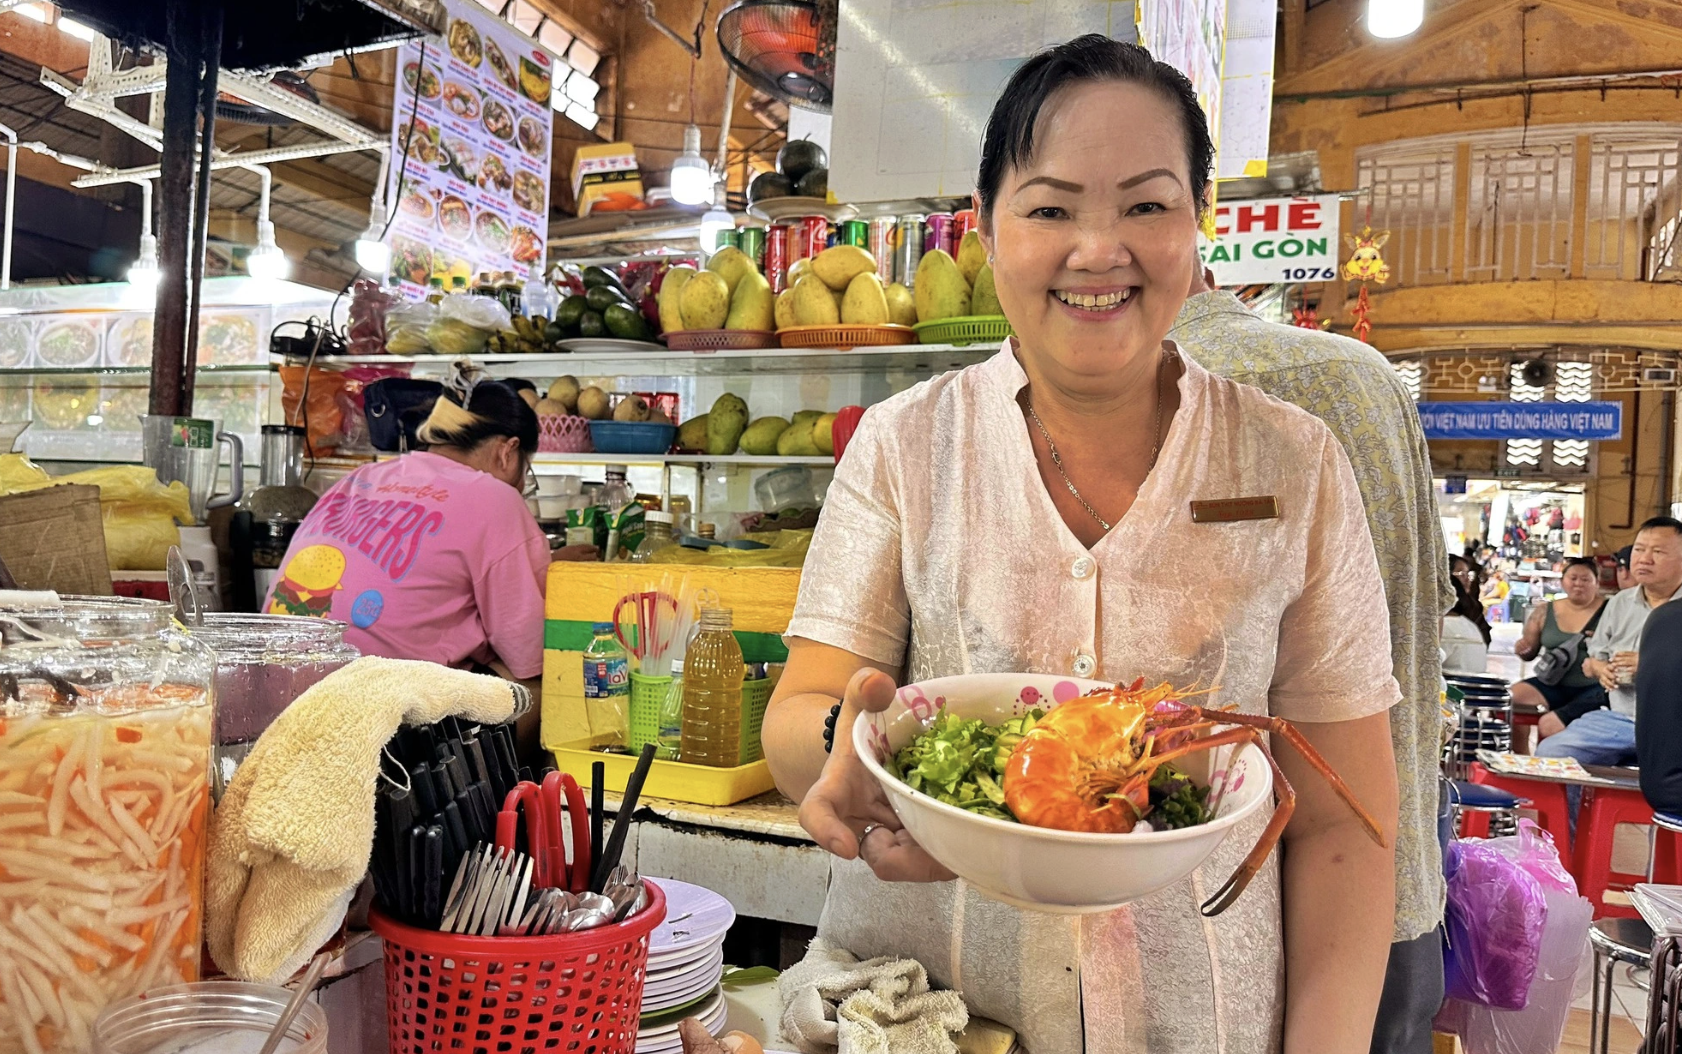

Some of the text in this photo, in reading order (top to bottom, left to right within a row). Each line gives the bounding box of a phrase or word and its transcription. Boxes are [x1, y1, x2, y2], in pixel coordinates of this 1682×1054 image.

[1252, 232, 1327, 259] GÒN
[1282, 268, 1335, 280] 1076
[1435, 410, 1455, 432] VIỆT
[1455, 412, 1476, 430] NAM
[1541, 409, 1568, 430] HÀNG
[1569, 410, 1590, 433] VIỆT
[1591, 412, 1613, 430] NAM
